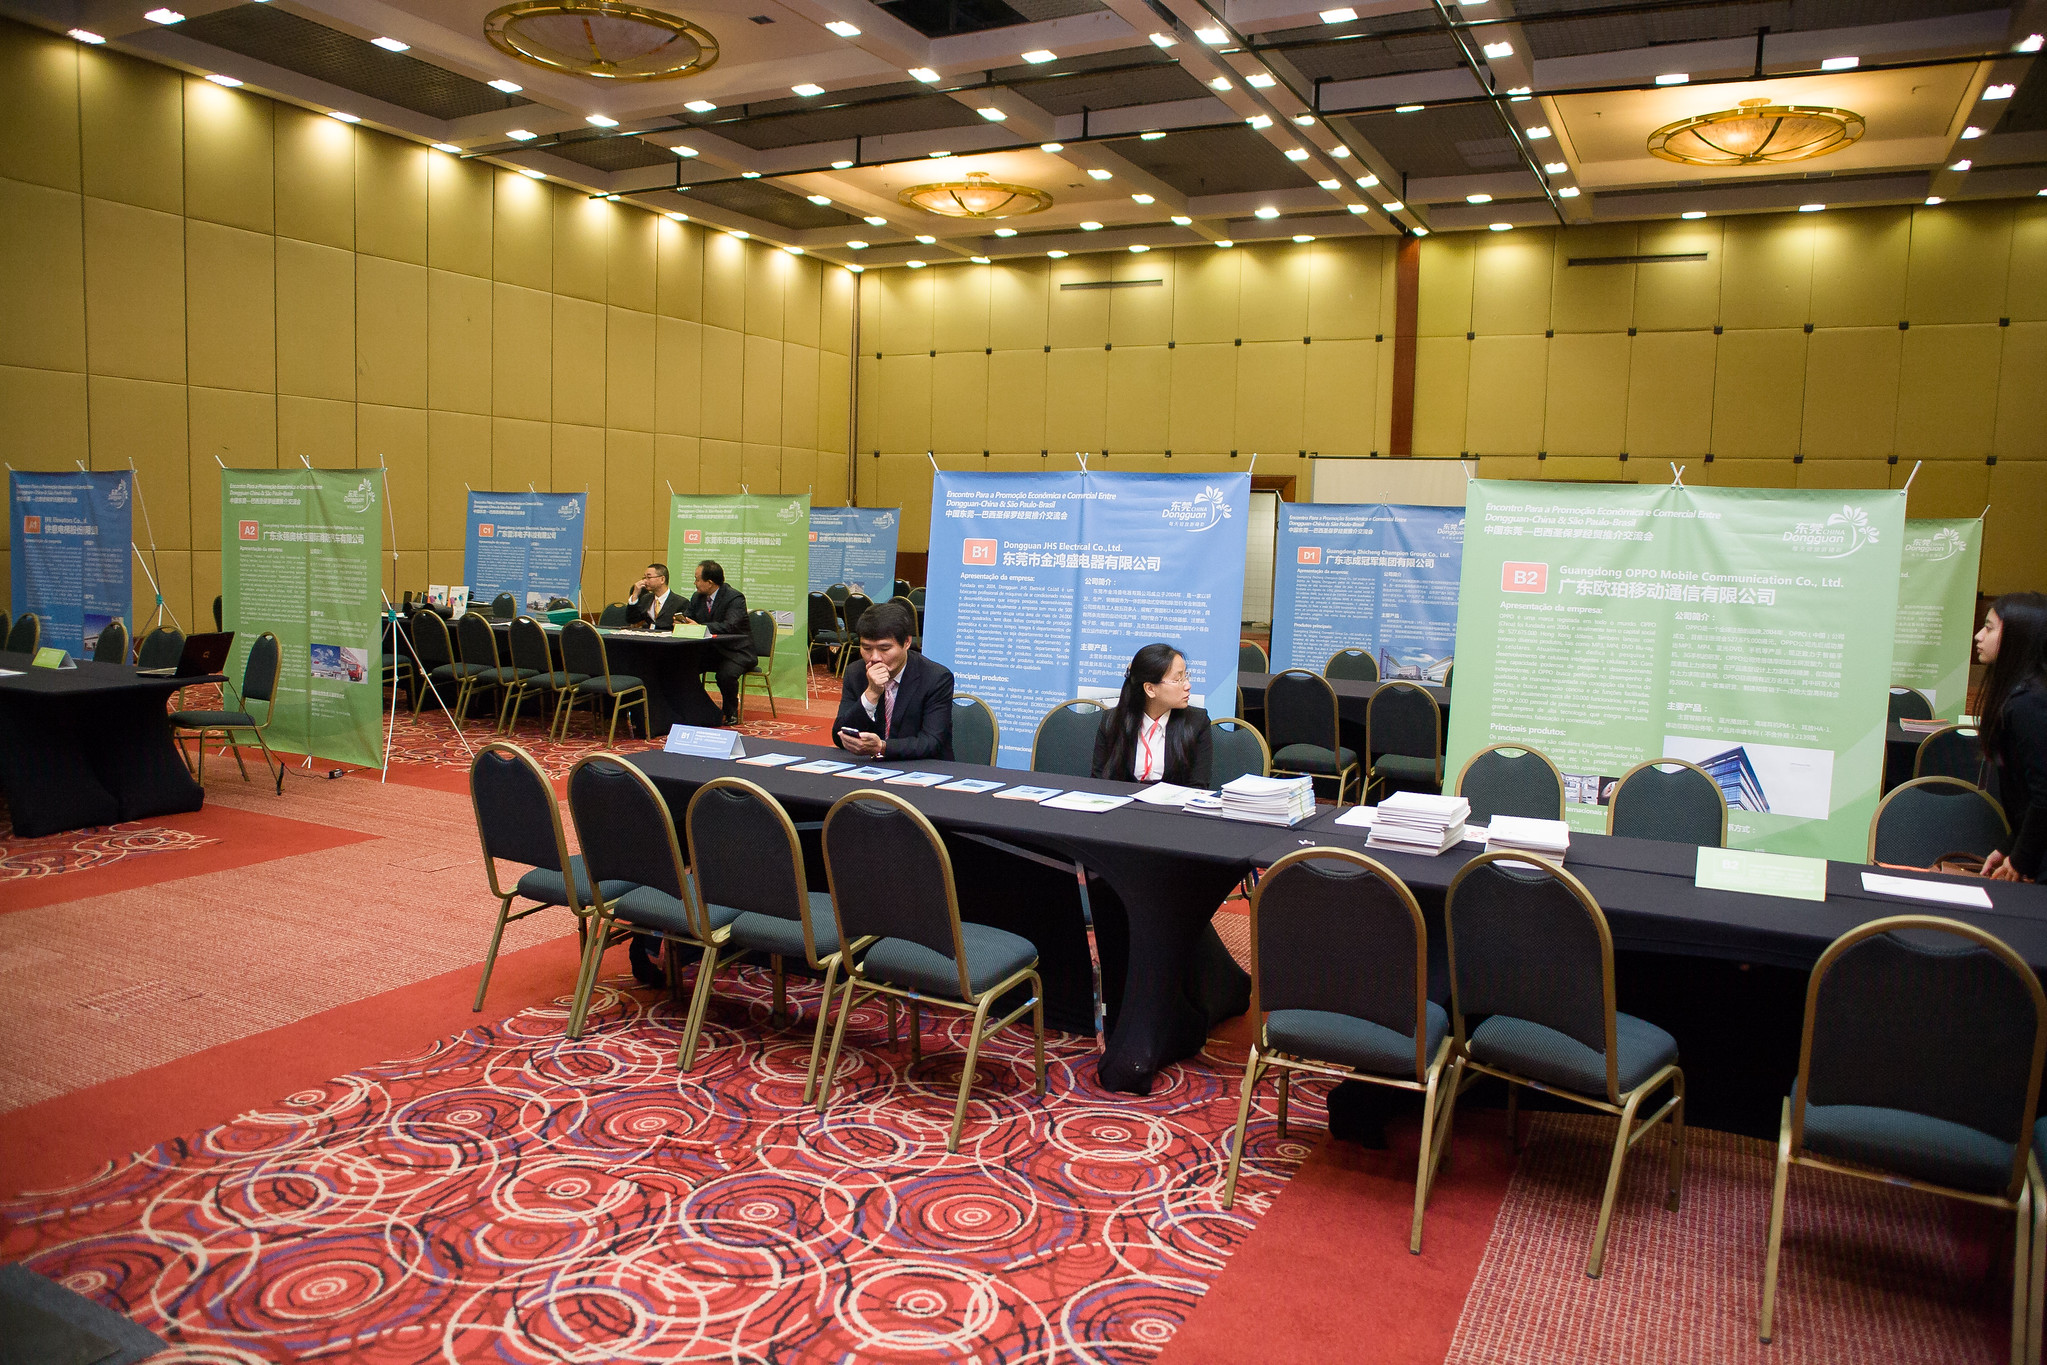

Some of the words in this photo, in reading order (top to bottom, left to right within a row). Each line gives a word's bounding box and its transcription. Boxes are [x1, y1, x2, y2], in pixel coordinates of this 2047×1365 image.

[995, 492, 1026, 500] Promoção
[946, 500, 998, 508] Dongguan-China
[1171, 501, 1192, 511] 东莞
[1162, 509, 1206, 520] Dongguan
[1486, 503, 1522, 512] Encontro
[1525, 505, 1542, 513] Para
[1552, 506, 1595, 516] Promoção
[1597, 508, 1644, 517] Econômica
[1653, 509, 1696, 518] Comercial
[1698, 511, 1721, 519] Entre
[1485, 514, 1556, 524] Dongguan-China
[1557, 516, 1566, 525] &
[1567, 516, 1583, 525] São
[1585, 517, 1636, 527] Paulo-Brasil
[244, 526, 255, 535] A2
[1794, 522, 1824, 534] 东莞
[1783, 531, 1844, 545] Dongguan
[972, 546, 989, 558] B1
[1004, 541, 1042, 551] Dongguan
[1059, 543, 1090, 551] Electrical
[1092, 544, 1123, 553] Co.,Ltd.
[1003, 552, 1161, 572] 东莞市金鸿盛电器有限公司
[1326, 555, 1435, 568] 广东志成冠军集团有限公司
[960, 572, 999, 581] Apresentação
[1514, 570, 1538, 585] B2
[1560, 565, 1622, 581] Guangdong
[1626, 568, 1657, 578] OPPO
[1660, 569, 1699, 581] Mobile
[1702, 571, 1793, 584] Communication
[1796, 574, 1819, 587] Co.,
[1822, 574, 1844, 588] Ltd.
[1558, 579, 1776, 606] 广东欧珀移动通信有限公司
[1500, 601, 1552, 612] Apresentação
[1554, 603, 1565, 612] da
[1567, 605, 1603, 614] empresa:
[1675, 611, 1715, 621] 公司简介：
[954, 672, 980, 680] Principais
[1667, 702, 1708, 712] 主要产品：
[1490, 723, 1527, 733] Principais
[1529, 727, 1566, 736] produtos:
[1566, 806, 1602, 816] ternacionais
